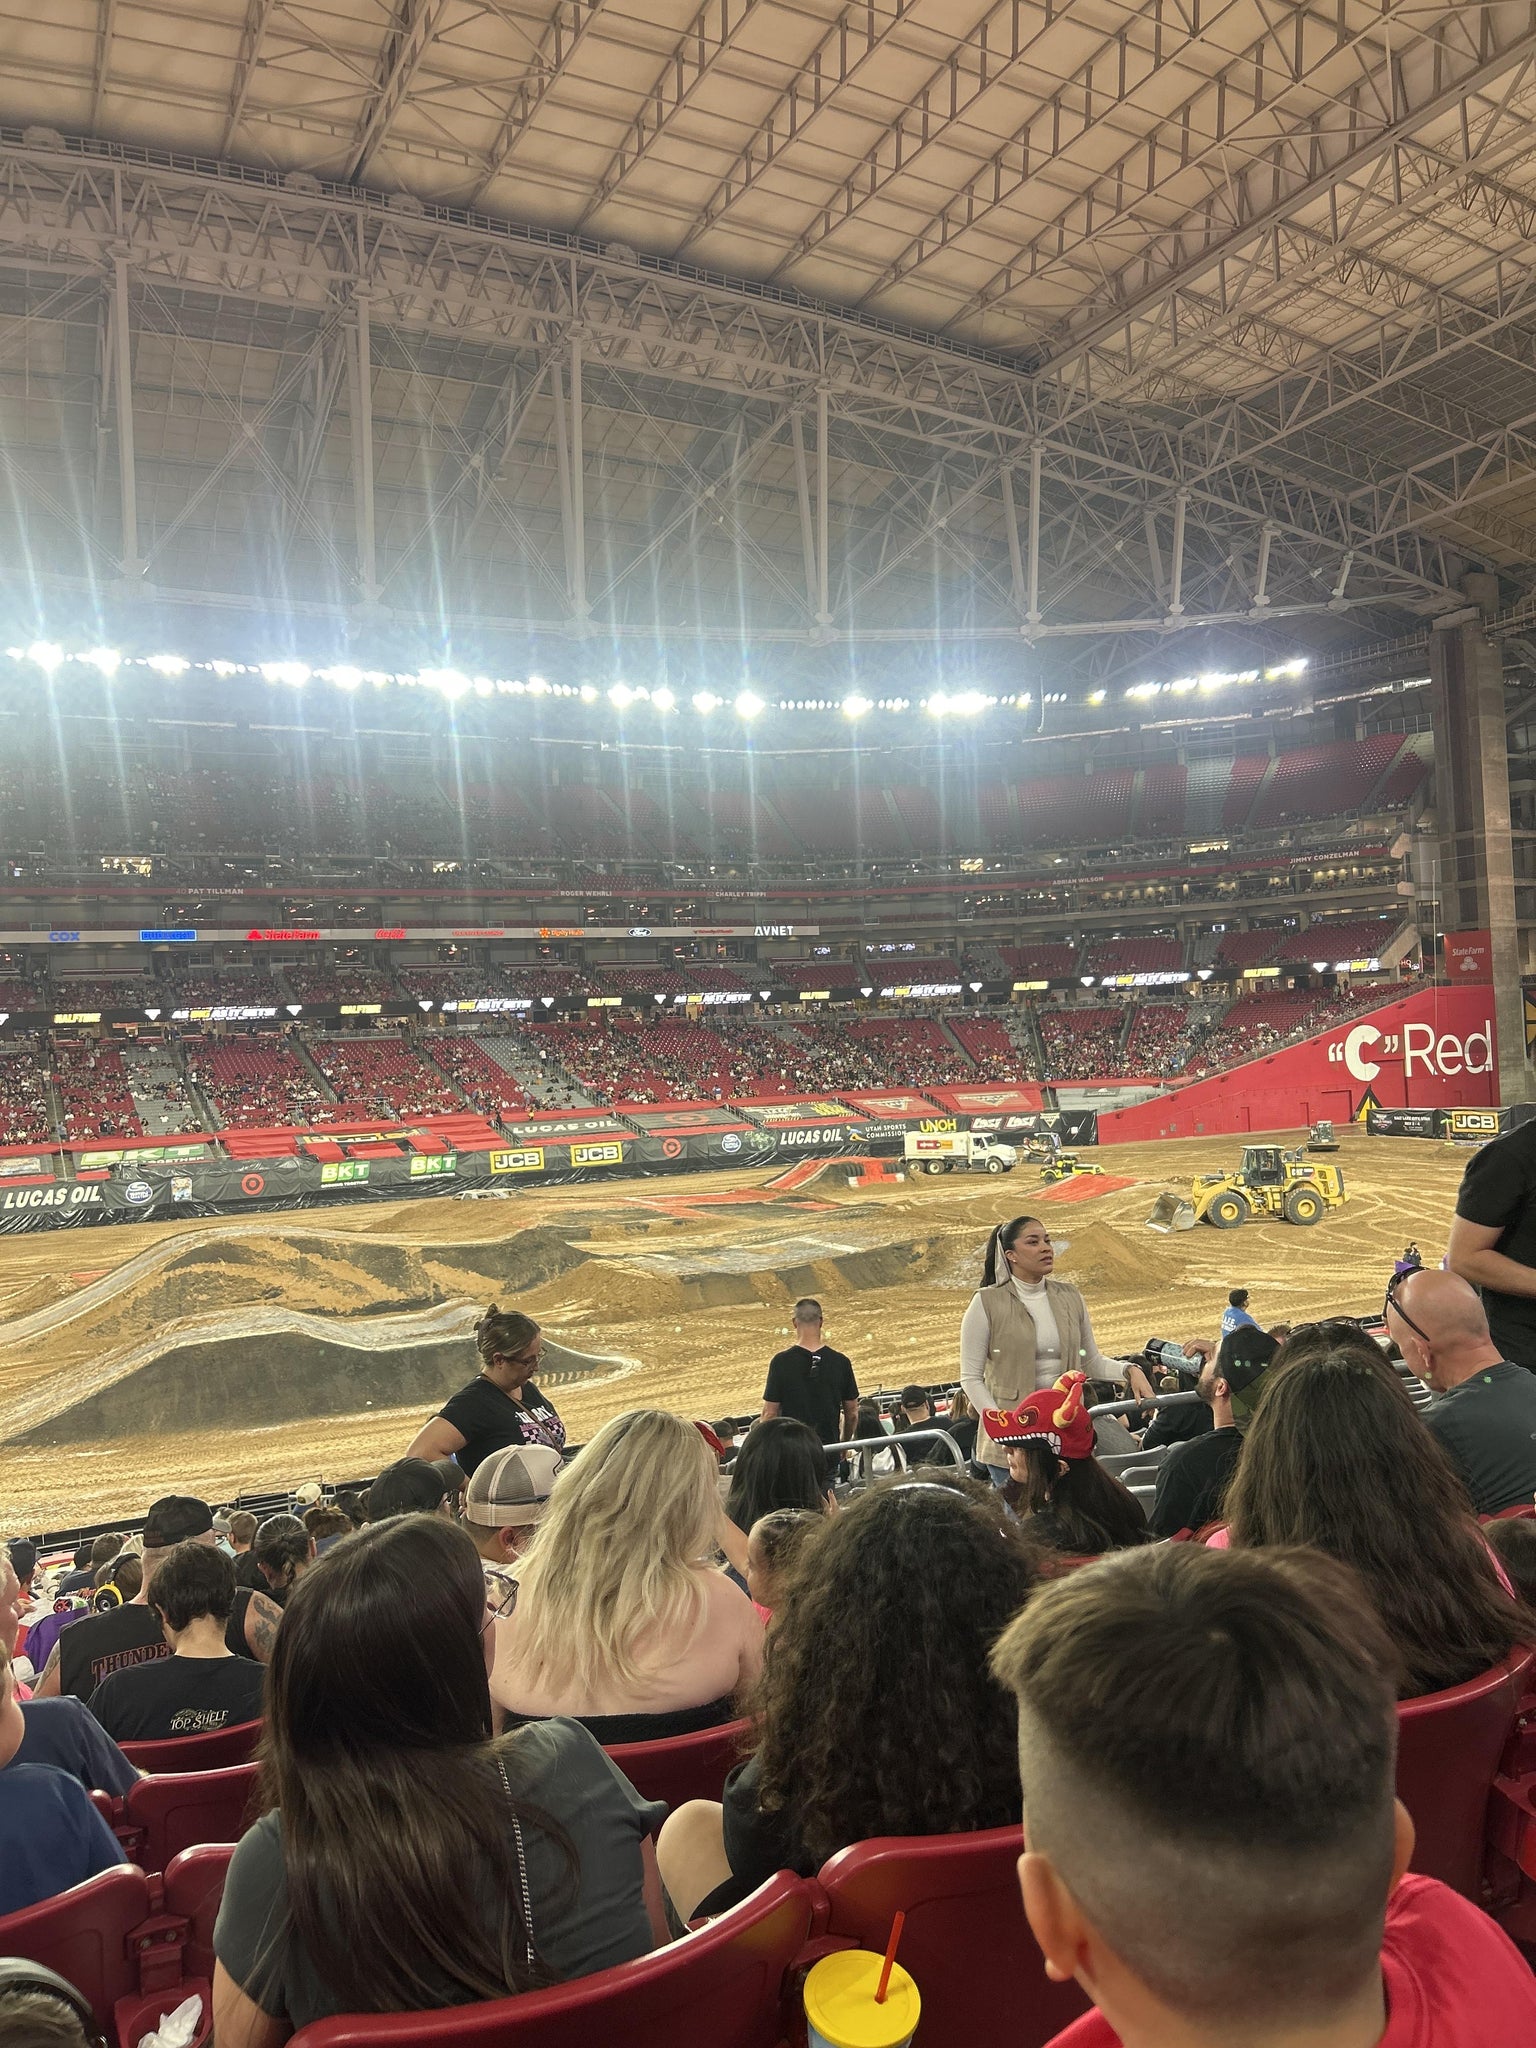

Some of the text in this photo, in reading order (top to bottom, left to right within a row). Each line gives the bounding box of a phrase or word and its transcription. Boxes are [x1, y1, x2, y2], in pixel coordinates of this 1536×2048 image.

[1289, 851, 1360, 864] JIMMY CONZELMAN
[49, 931, 80, 942] COX
[754, 925, 794, 936] AVNET
[1403, 1020, 1493, 1077] Red
[513, 1123, 578, 1134] LUCAS
[920, 1119, 956, 1132] UNOH
[1456, 1116, 1494, 1129] JCB
[780, 1130, 820, 1145] LUCAS
[866, 1130, 907, 1139] COMMISSION
[495, 1152, 539, 1169] JCB
[576, 1146, 618, 1162] JCB
[322, 1162, 370, 1182] BKT
[412, 1155, 457, 1174] BKT
[4, 1187, 68, 1209] LUCAS
[170, 1710, 229, 1731] TOP SHELF
